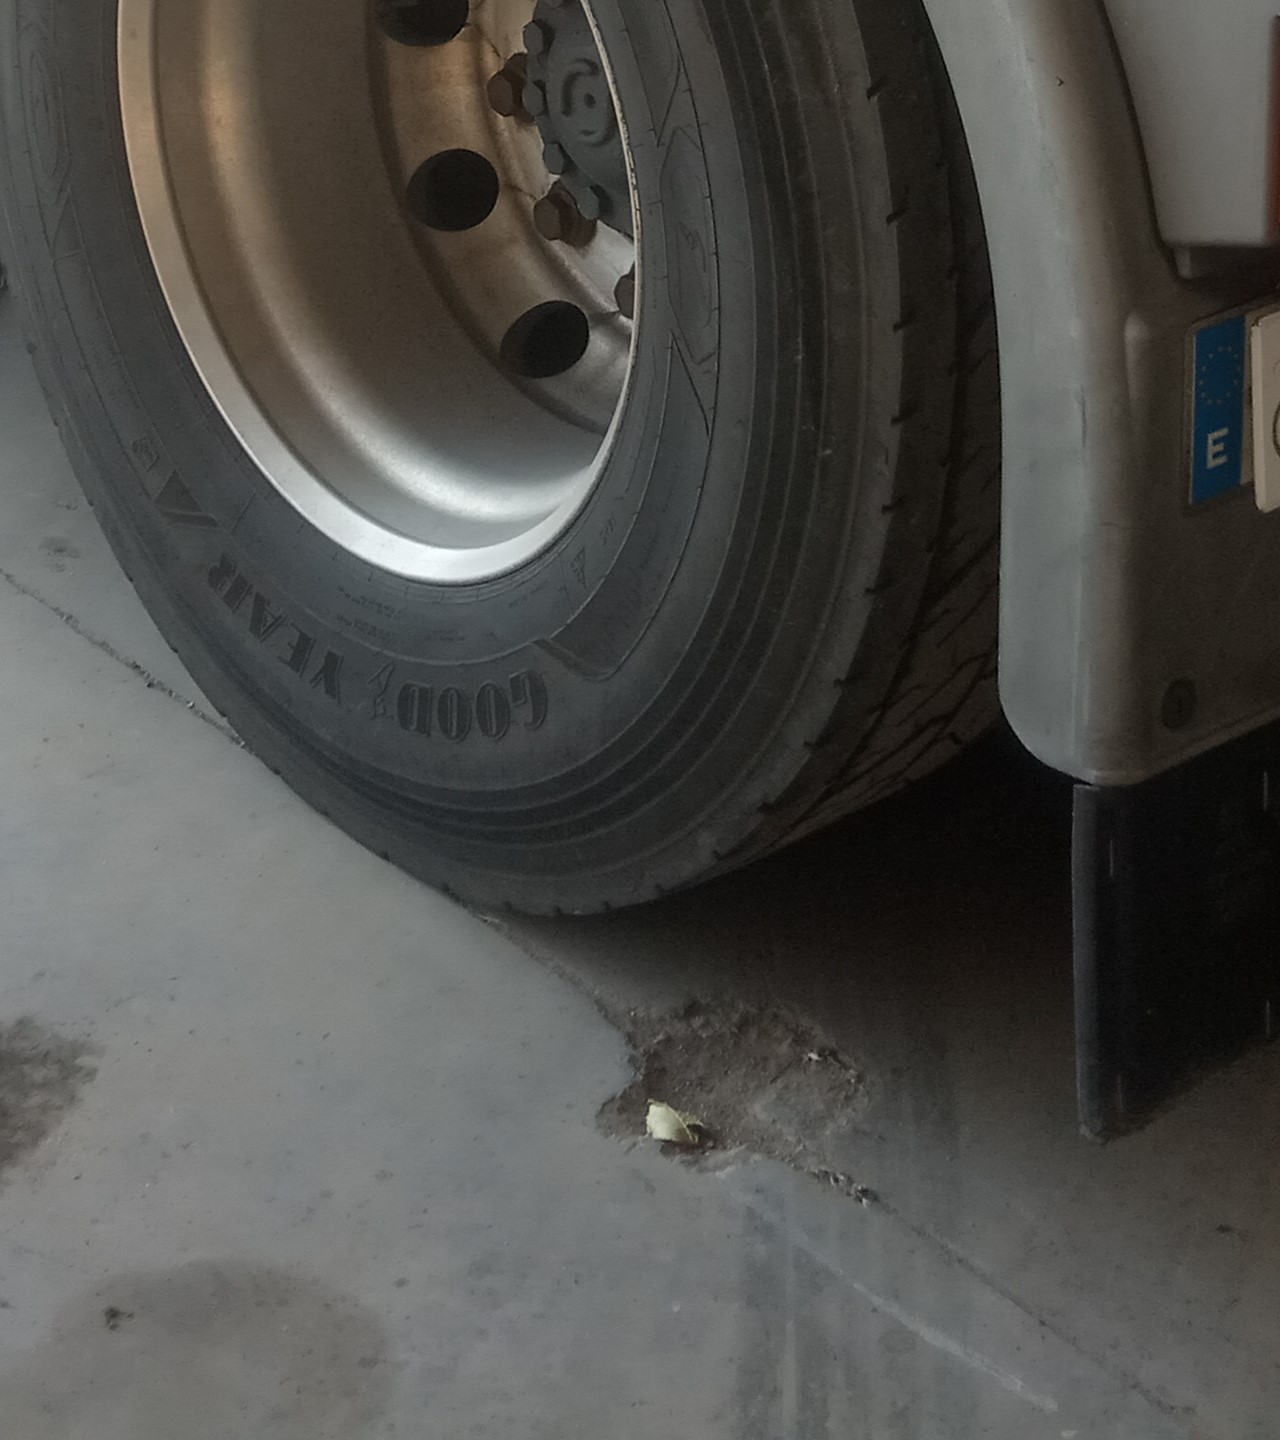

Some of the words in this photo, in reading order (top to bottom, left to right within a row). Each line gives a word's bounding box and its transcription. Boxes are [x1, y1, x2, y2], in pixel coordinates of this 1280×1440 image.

[1205, 426, 1230, 471] E
[206, 553, 345, 706] YEAR
[396, 667, 549, 744] GOOD
